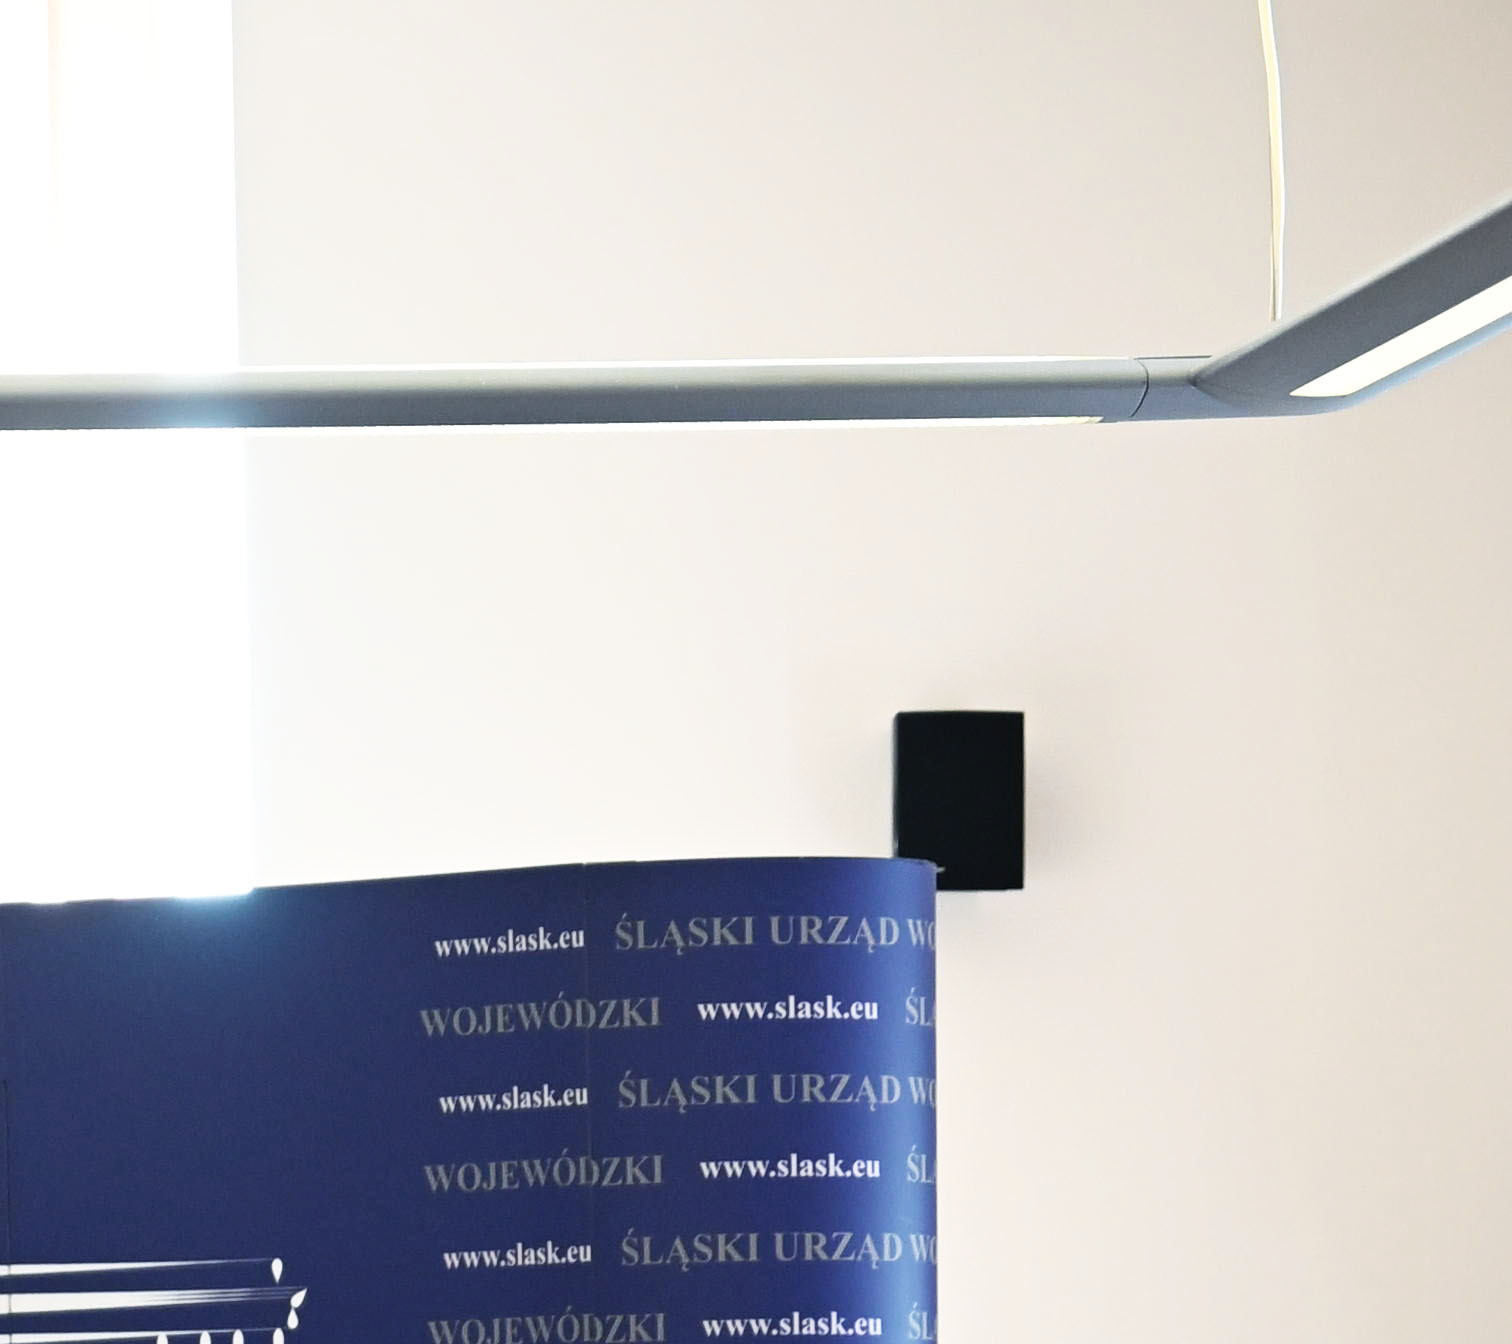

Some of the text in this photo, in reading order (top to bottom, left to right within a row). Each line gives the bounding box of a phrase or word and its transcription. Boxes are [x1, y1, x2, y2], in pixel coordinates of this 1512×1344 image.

[435, 927, 584, 956] www.slask.eu
[616, 913, 753, 955] ŚLĄSKI
[771, 916, 899, 953] URZĄD
[420, 991, 659, 1036] WOJEWÓDZKI
[698, 995, 877, 1020] www.slask.eu
[439, 1084, 588, 1112] www.slask.eu
[619, 1070, 756, 1113] ŚLĄSKI
[773, 1074, 900, 1111] URZĄD
[424, 1148, 662, 1191] WOJEWÓDZKI
[700, 1153, 880, 1178] www.slask.eu
[444, 1241, 591, 1268] www.slask.eu
[622, 1228, 758, 1272] ŚLĄSKI
[774, 1232, 902, 1269] URZĄD
[703, 1311, 881, 1336] www.slask.eu
